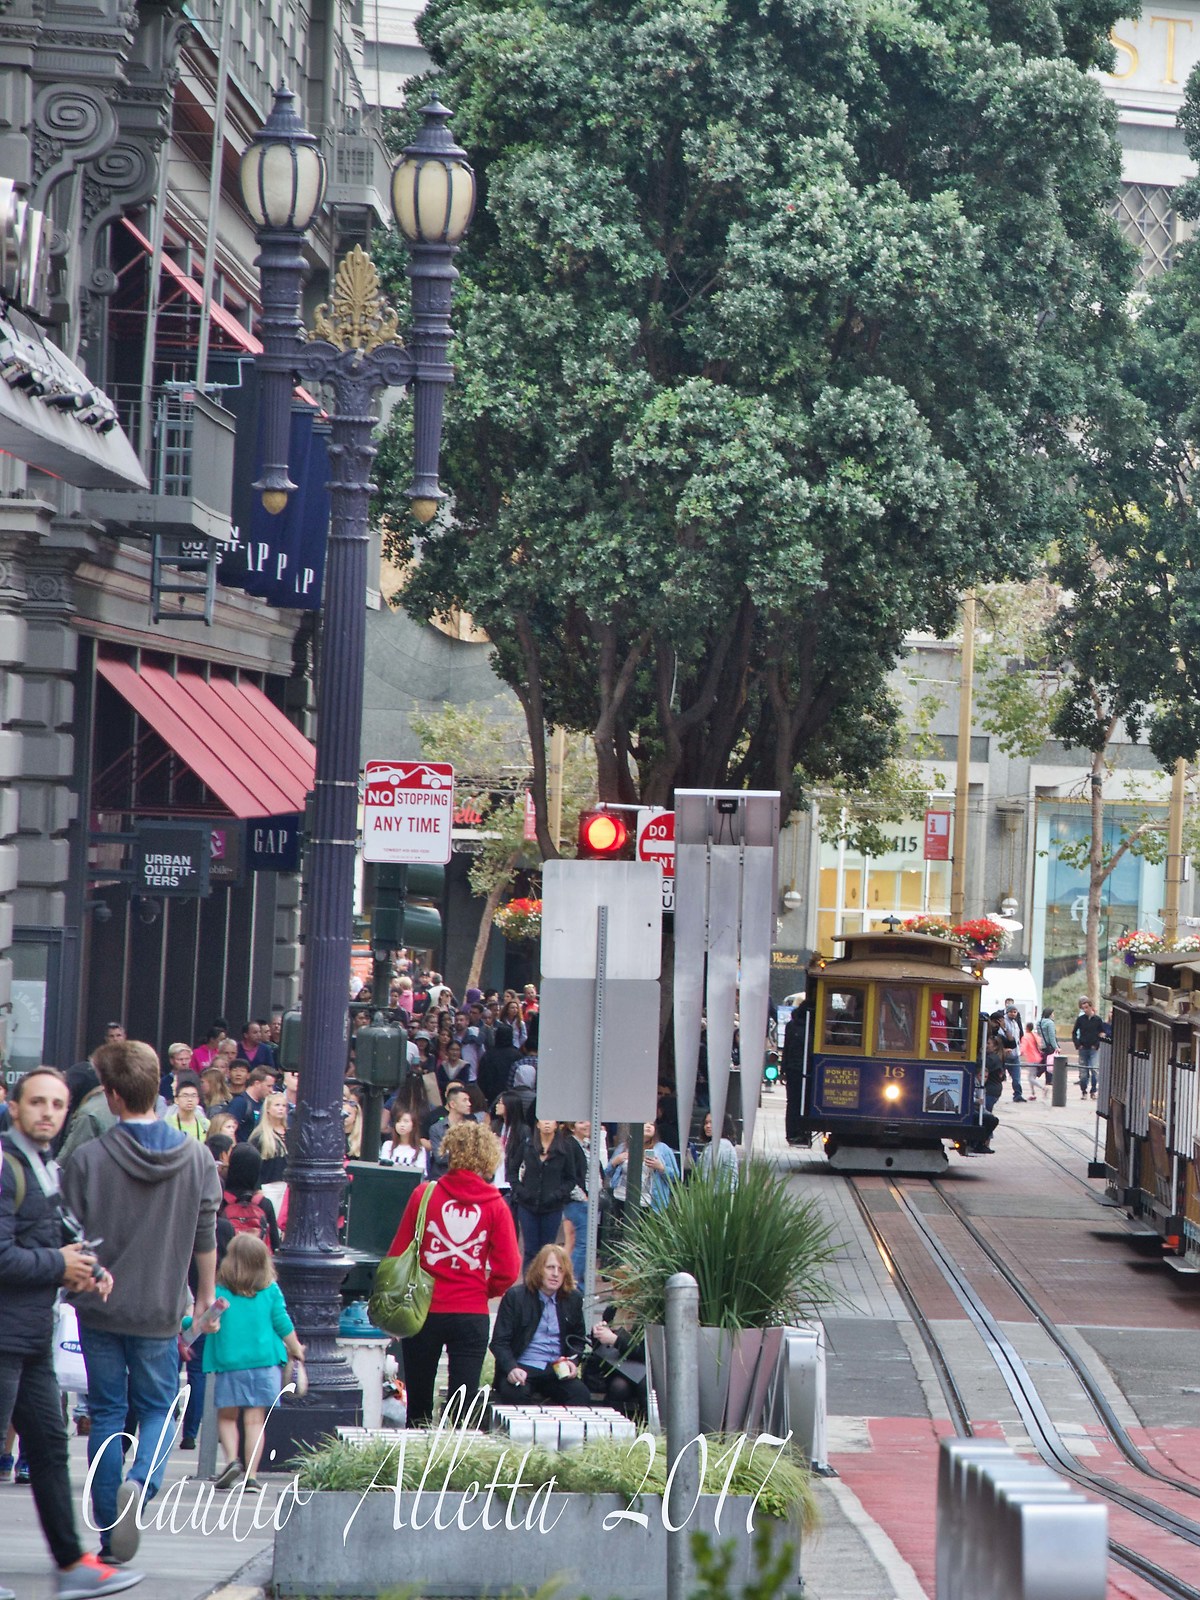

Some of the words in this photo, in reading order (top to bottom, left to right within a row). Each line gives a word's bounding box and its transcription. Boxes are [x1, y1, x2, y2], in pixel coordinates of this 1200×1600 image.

[367, 790, 394, 804] NO
[397, 793, 448, 806] STOPPING
[374, 816, 402, 832] ANY
[408, 817, 441, 833] TIME
[649, 825, 667, 837] DO
[254, 829, 288, 854] GAP
[145, 854, 191, 866] URBAN
[144, 865, 196, 876] OUTFIT-
[145, 876, 179, 887] TERS
[884, 1065, 905, 1078] 16
